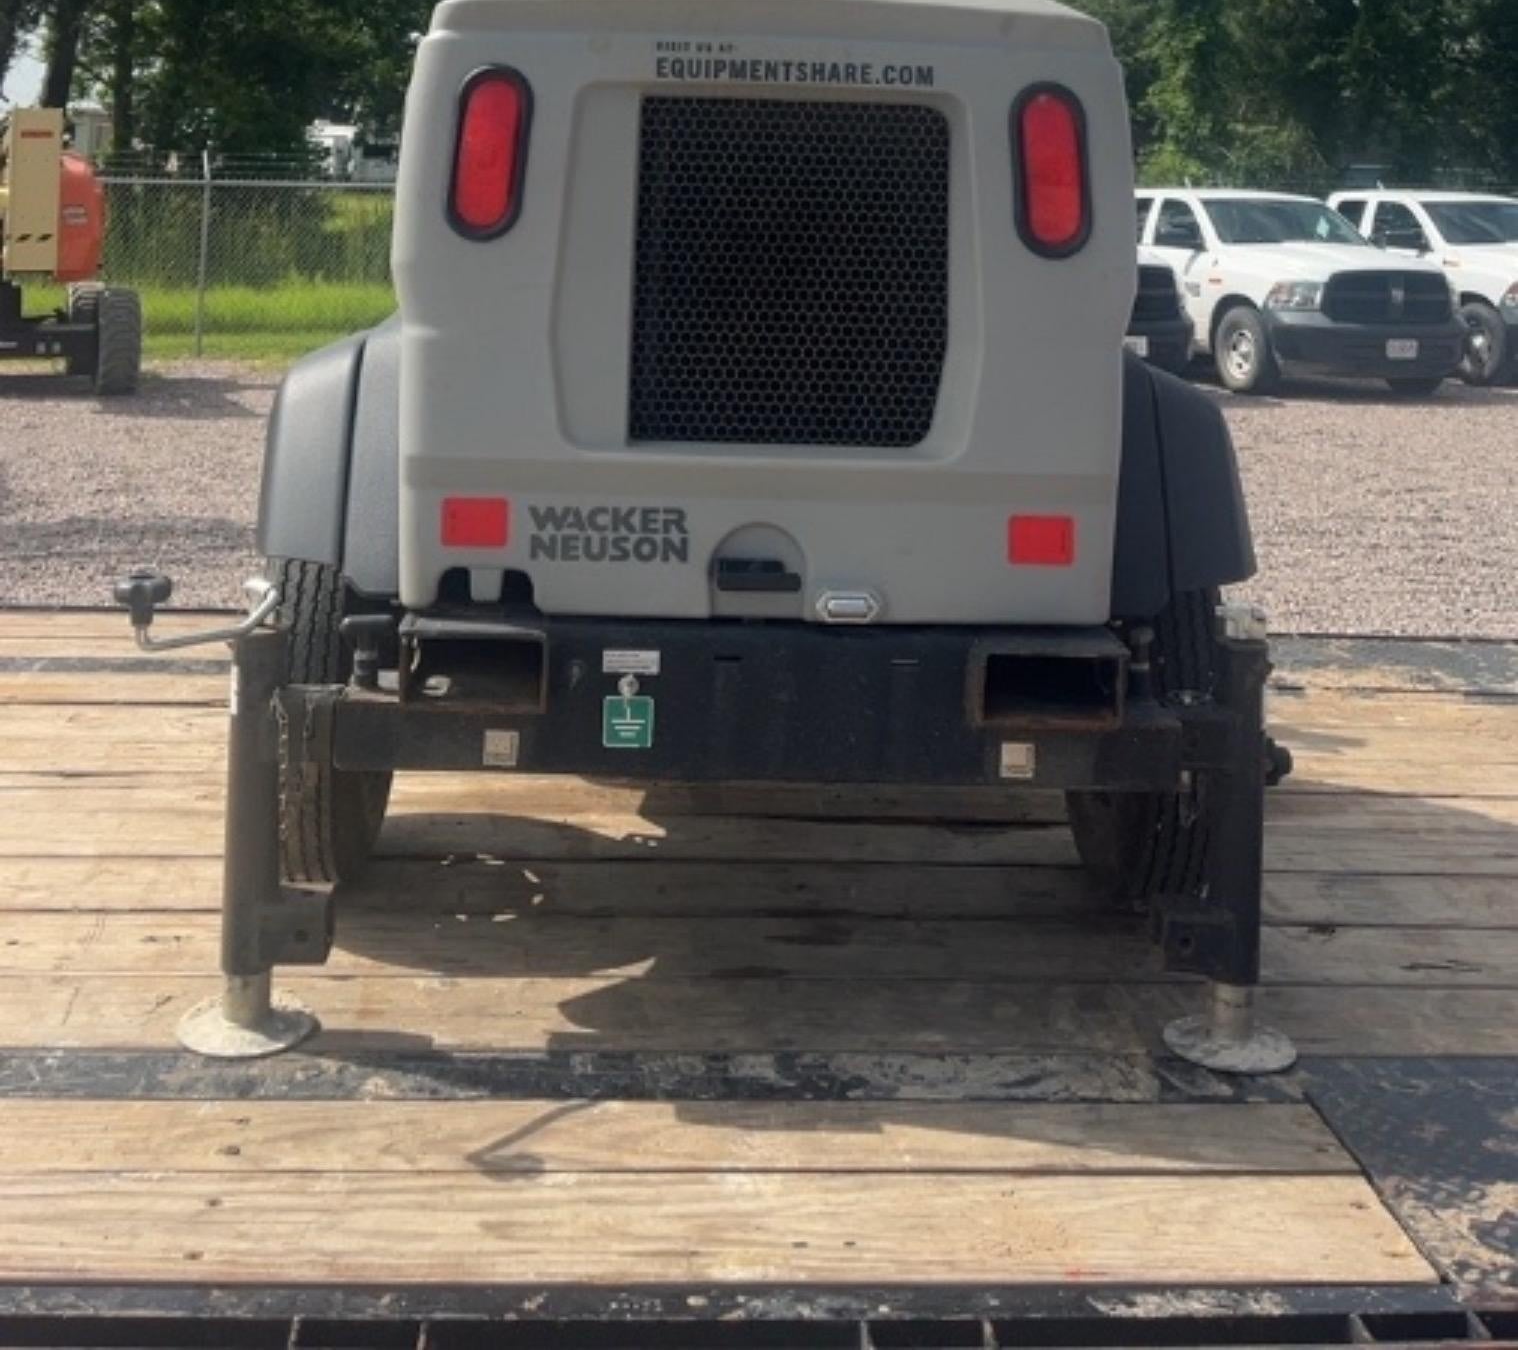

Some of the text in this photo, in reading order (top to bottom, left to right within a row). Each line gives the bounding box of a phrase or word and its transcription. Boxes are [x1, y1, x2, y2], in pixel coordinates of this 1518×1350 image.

[656, 57, 934, 87] EQUIPMENTSHARE.COM
[528, 505, 689, 534] WACKER
[529, 534, 689, 562] NEUSON
